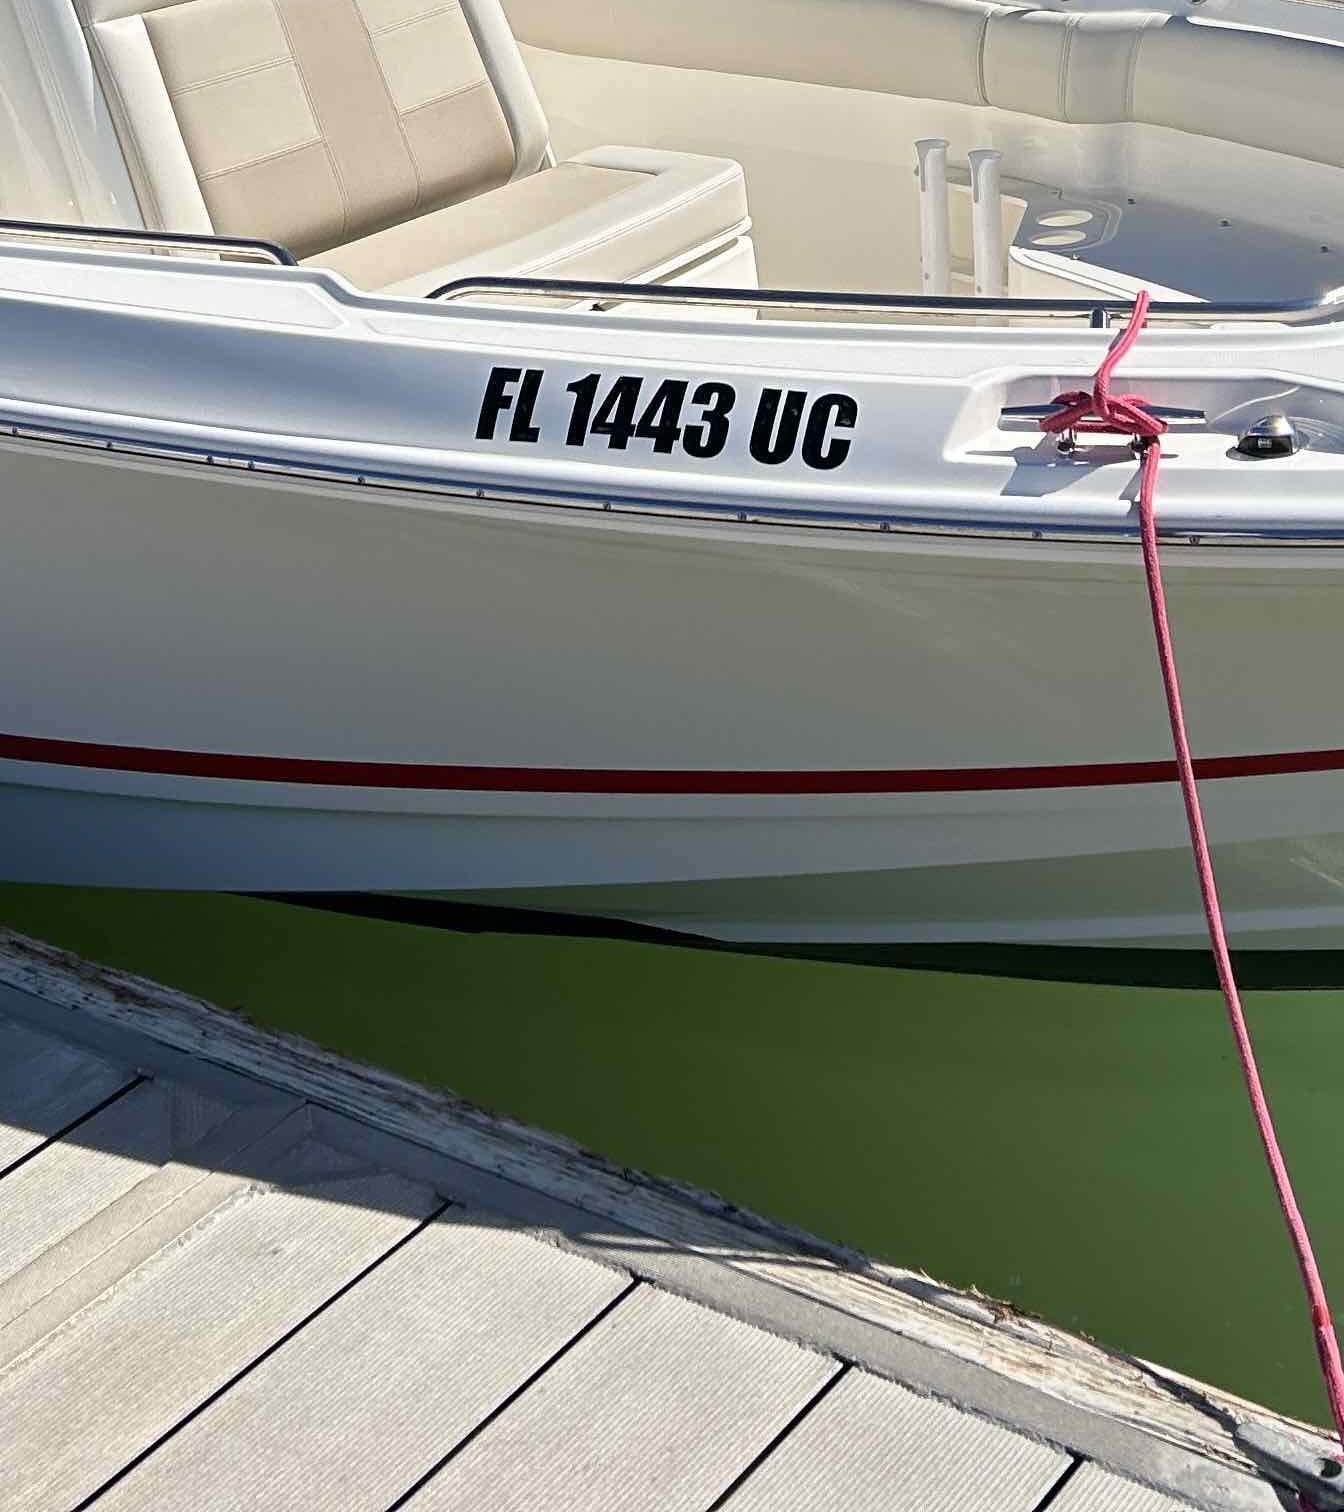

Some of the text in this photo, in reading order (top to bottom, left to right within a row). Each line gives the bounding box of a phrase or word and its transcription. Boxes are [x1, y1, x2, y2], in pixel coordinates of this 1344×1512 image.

[476, 367, 858, 471] FL 1443 UC
